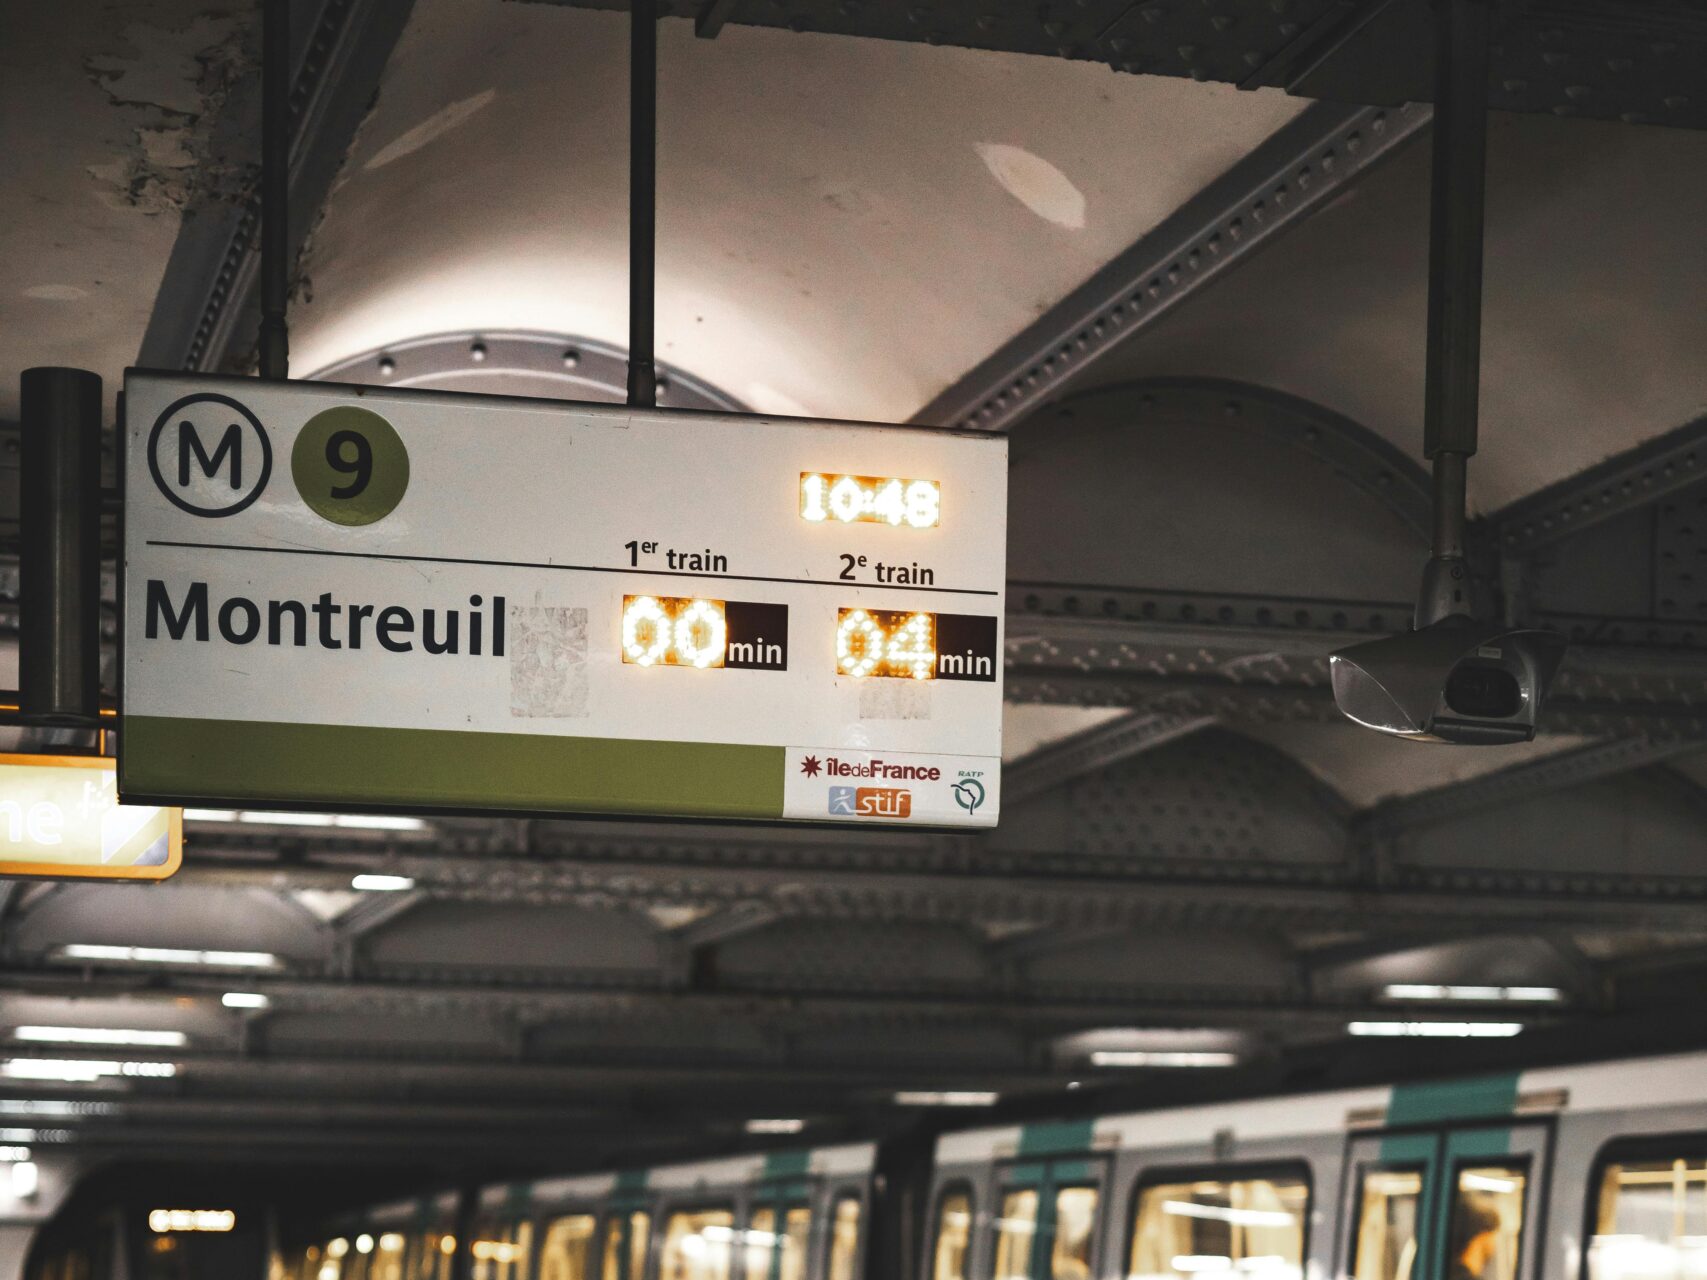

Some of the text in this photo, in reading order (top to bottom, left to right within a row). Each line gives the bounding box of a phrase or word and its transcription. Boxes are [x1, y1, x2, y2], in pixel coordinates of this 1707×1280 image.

[178, 420, 373, 500] M 9
[801, 474, 940, 528] 10:48
[624, 540, 728, 572] 1er train
[839, 553, 934, 585] 2e train
[145, 579, 506, 657] Montreuil
[622, 596, 783, 668] 00 min
[837, 609, 992, 679] 04 min
[957, 770, 985, 778] RATP
[860, 789, 912, 816] stif
